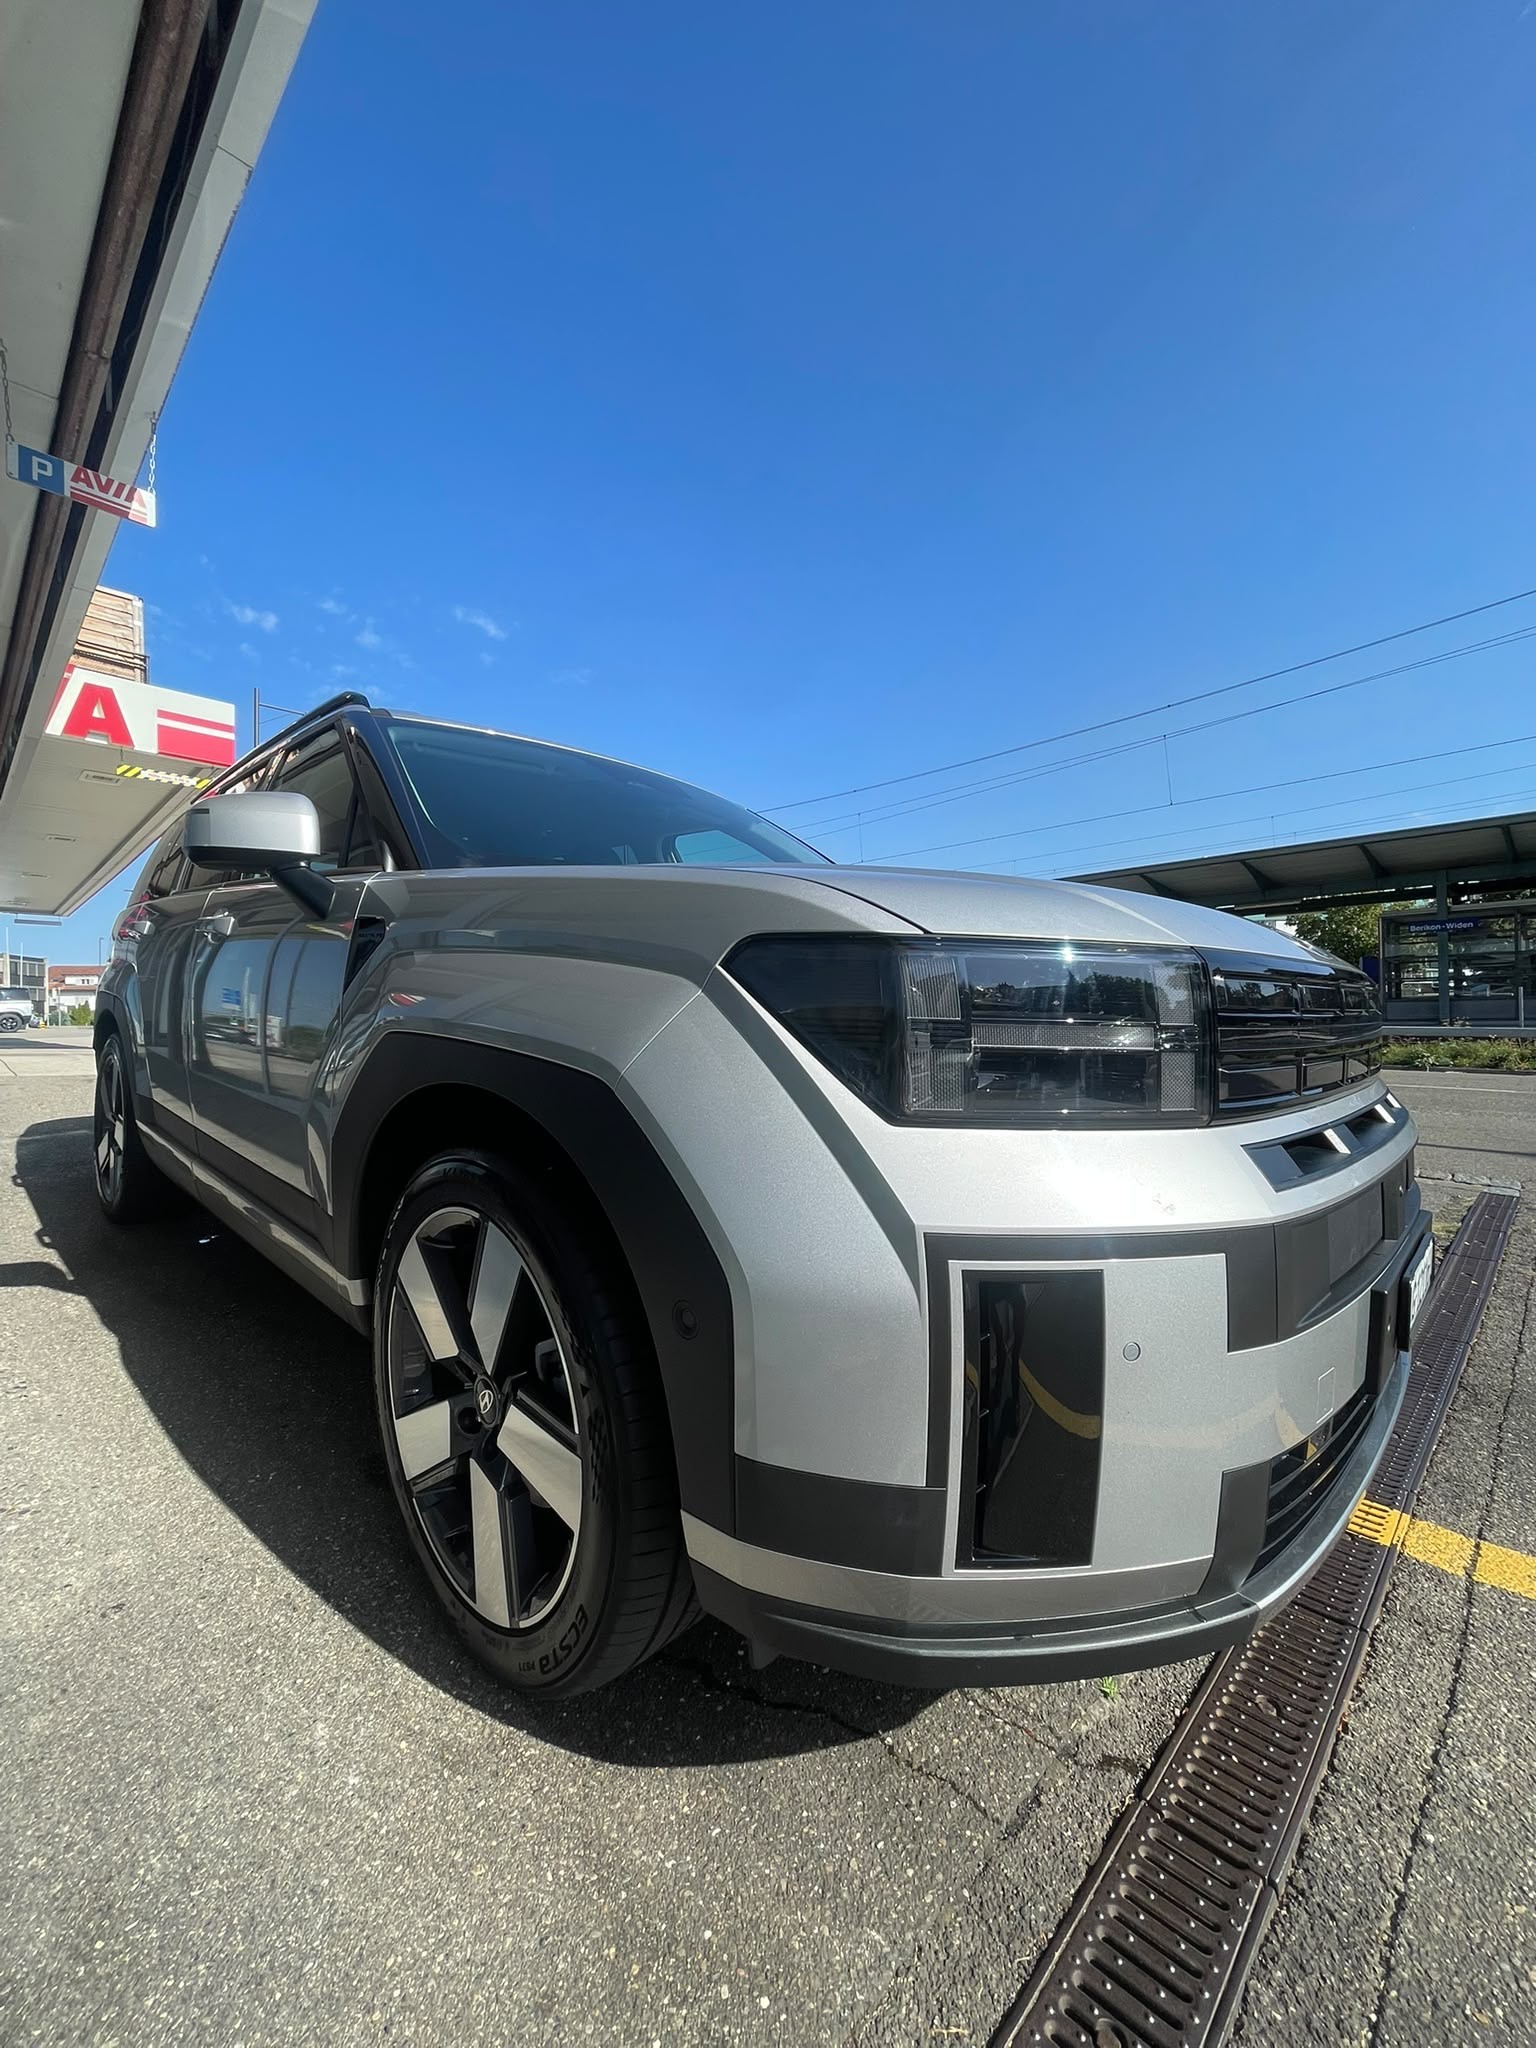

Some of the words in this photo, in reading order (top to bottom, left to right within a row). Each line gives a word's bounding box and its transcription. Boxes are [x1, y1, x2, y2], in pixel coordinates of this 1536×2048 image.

[31, 456, 53, 482] P
[70, 464, 147, 509] AVIA
[61, 681, 136, 749] A
